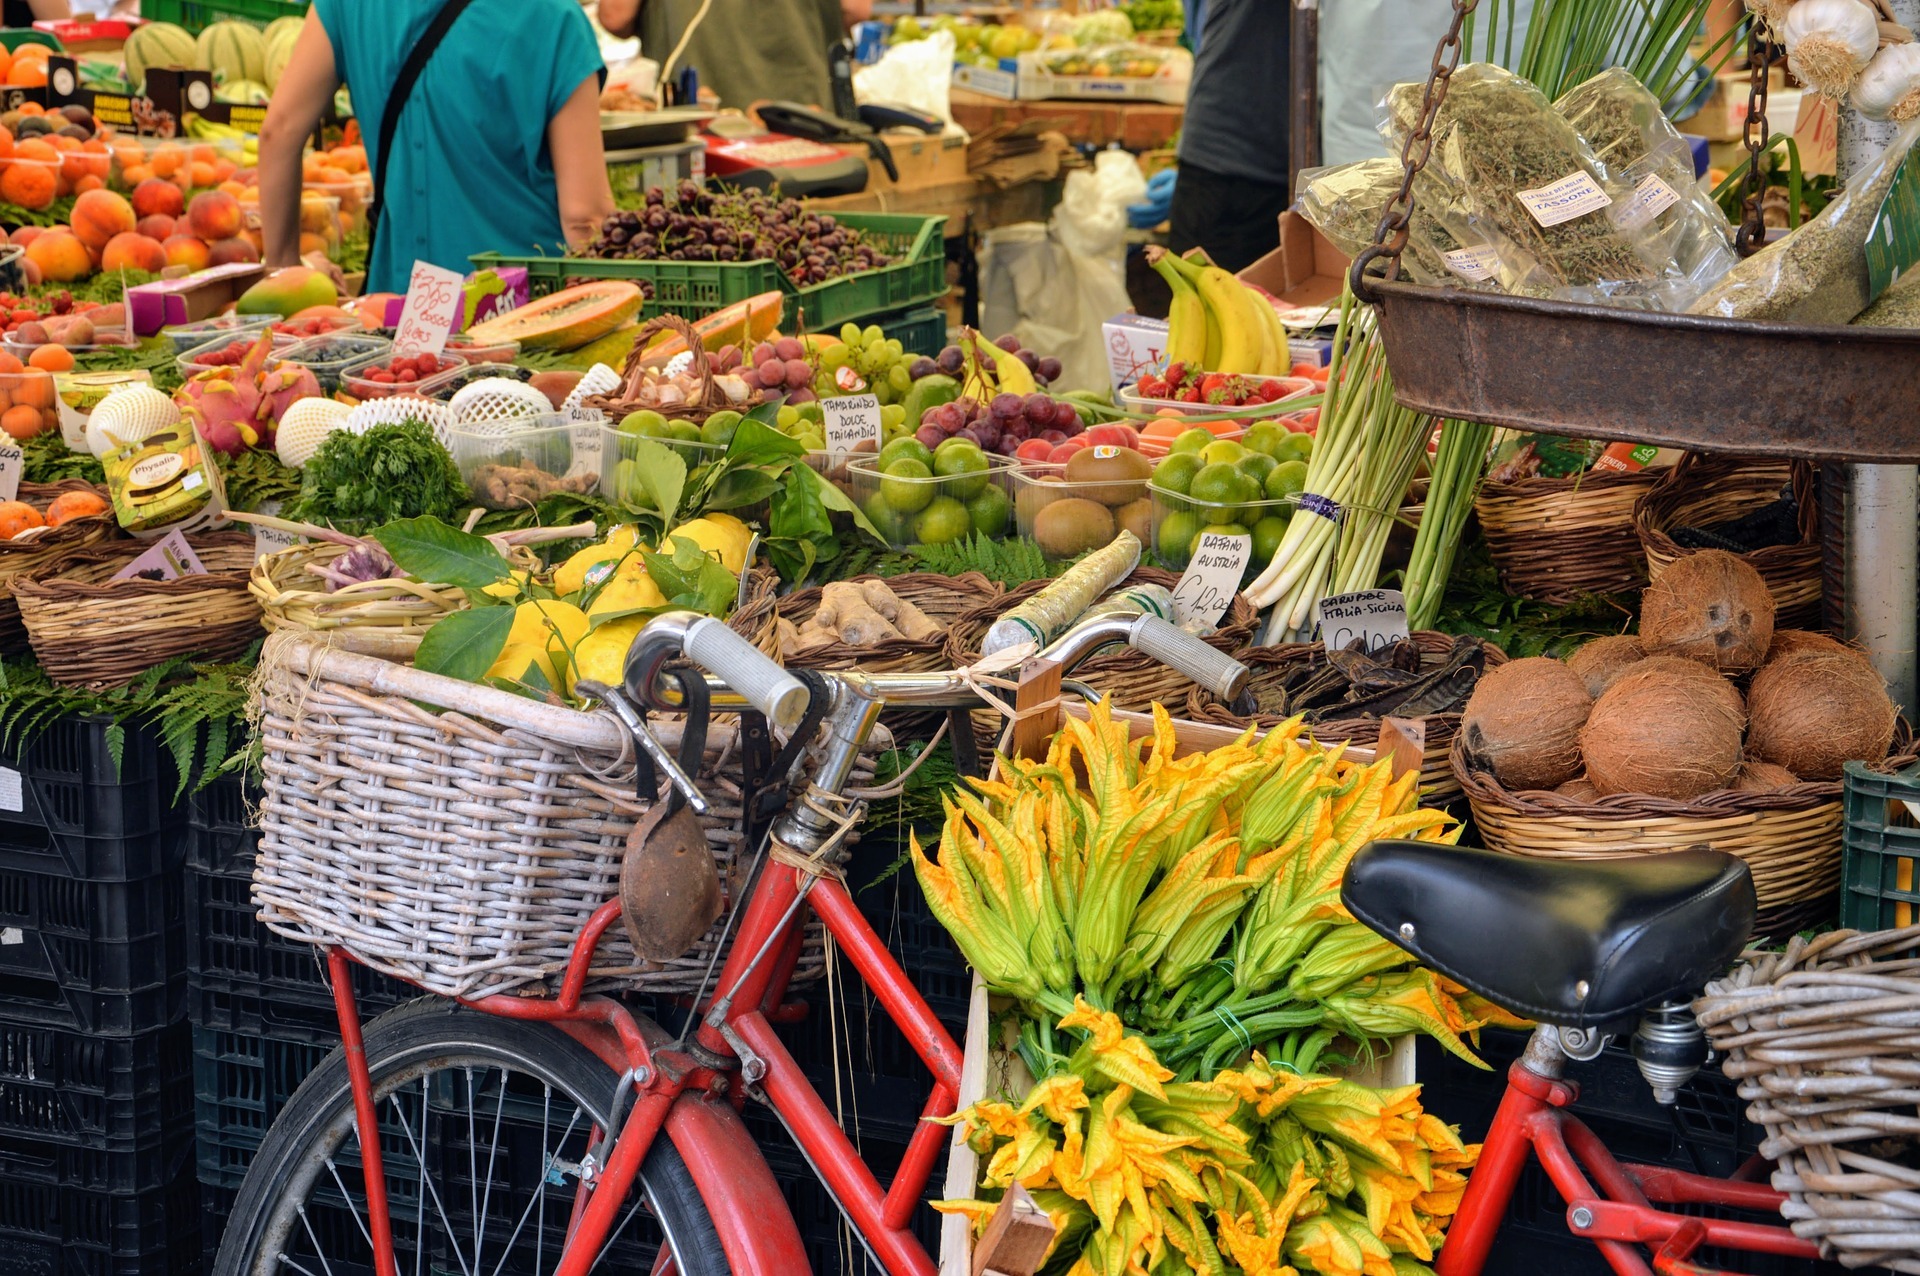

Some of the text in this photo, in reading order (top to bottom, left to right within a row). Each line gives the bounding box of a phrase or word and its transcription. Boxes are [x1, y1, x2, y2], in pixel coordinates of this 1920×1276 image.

[1534, 187, 1595, 210] TASSONE
[1554, 186, 1565, 194] DEI
[839, 413, 867, 427] DOLCE
[828, 424, 877, 441] TAILANDIA
[134, 455, 176, 475] Physalis
[1632, 451, 1649, 463] ecor
[152, 503, 193, 525] Physalis
[1202, 535, 1243, 552] RAFANO
[1197, 554, 1240, 570] AUSTRIA
